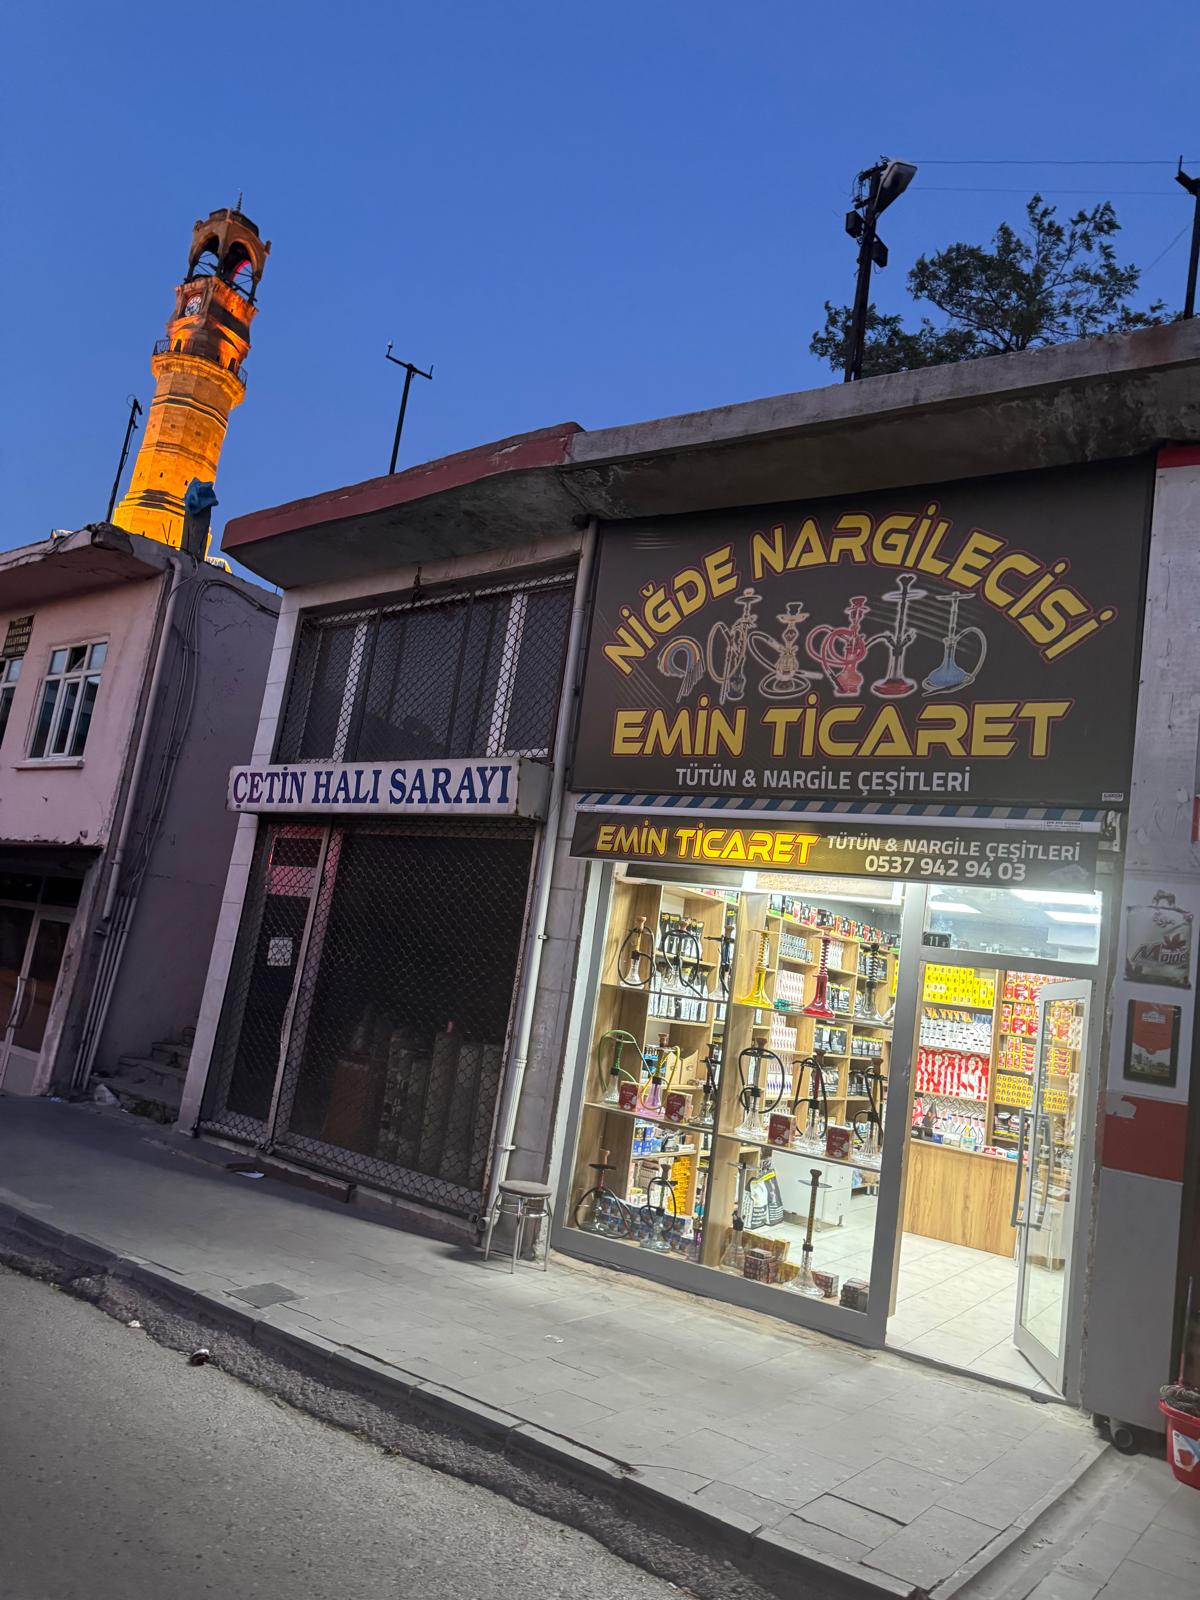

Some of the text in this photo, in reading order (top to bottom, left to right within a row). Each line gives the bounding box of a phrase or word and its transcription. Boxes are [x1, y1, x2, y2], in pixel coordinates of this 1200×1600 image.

[602, 502, 1114, 677] NİĞDE NARGİLECİSİ
[611, 692, 1073, 757] EMİN TİCARET
[232, 765, 513, 809] ÇETİN HALI SARAYI
[675, 763, 971, 797] TÜTÜN & NARGİLE ÇEŞİTLERİ
[595, 819, 819, 864] EMİN TİCARET
[827, 831, 1081, 864] TÜTÜN & NARGİLE ÇEŞİTLERİ
[864, 854, 1027, 882] 0537 942 94 03
